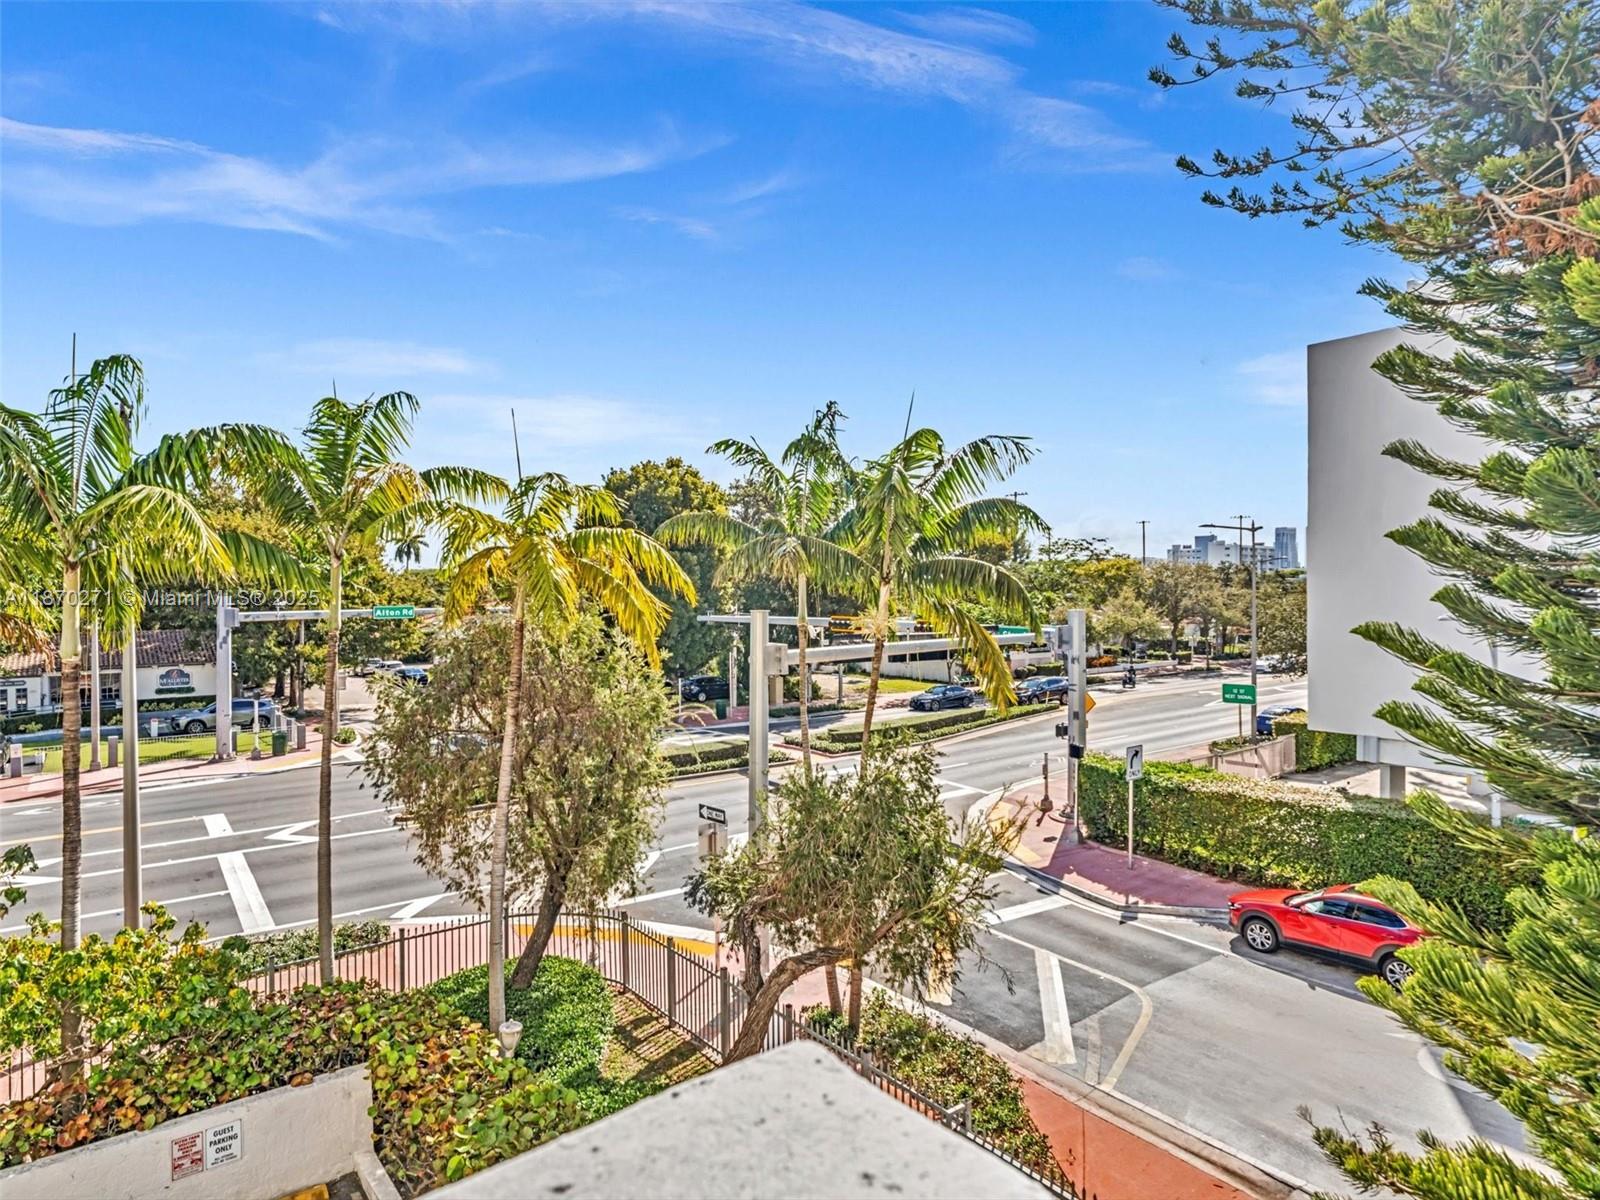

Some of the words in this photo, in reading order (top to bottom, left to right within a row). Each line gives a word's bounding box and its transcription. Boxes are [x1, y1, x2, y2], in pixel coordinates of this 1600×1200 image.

[402, 608, 413, 616] Rd
[213, 1125, 234, 1137] GUEST
[209, 1132, 239, 1148] PARKING
[215, 1143, 233, 1154] ONLY
